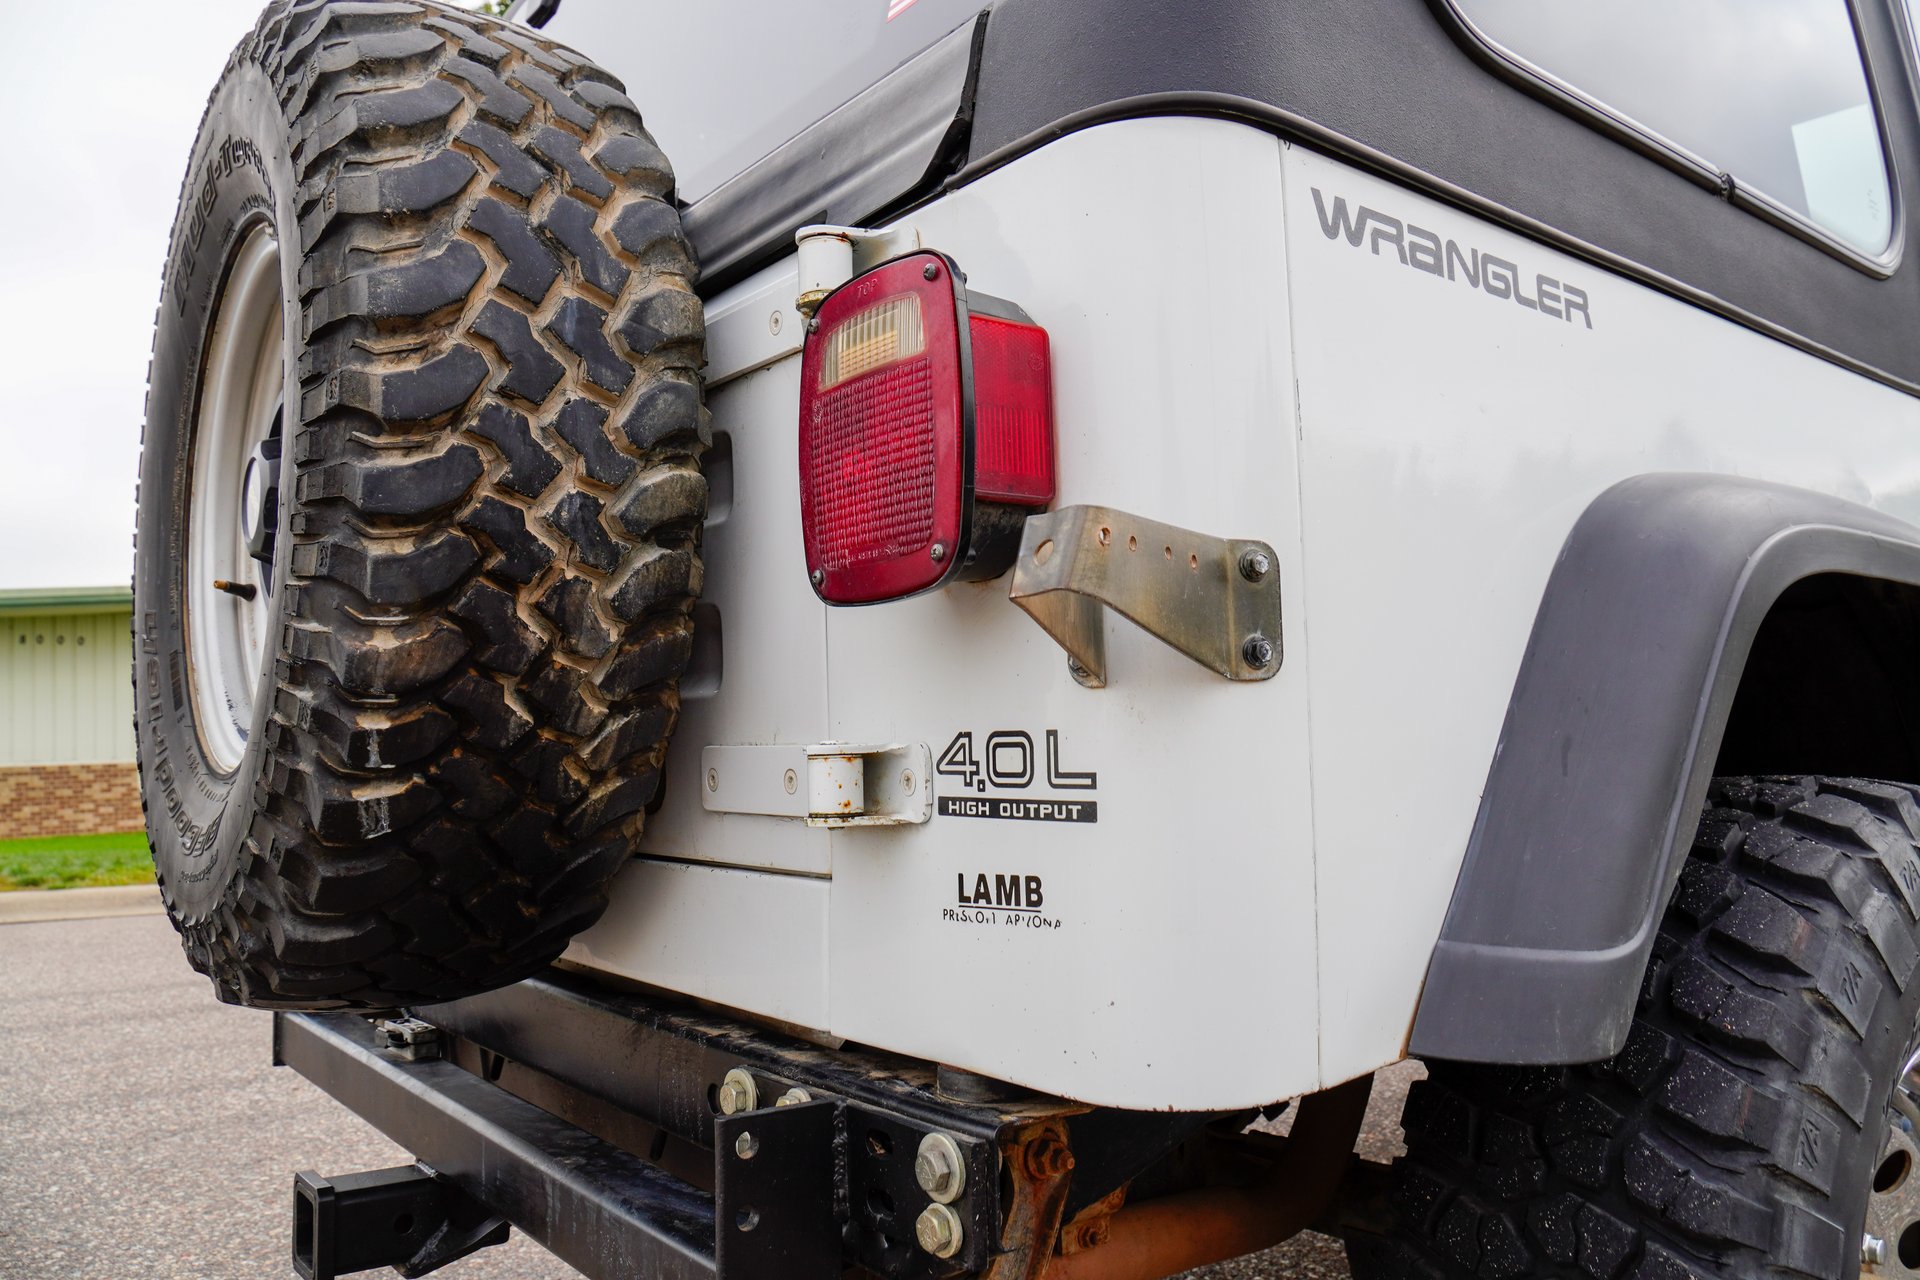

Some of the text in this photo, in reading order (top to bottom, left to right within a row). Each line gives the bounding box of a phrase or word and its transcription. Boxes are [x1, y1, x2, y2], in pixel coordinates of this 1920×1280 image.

[173, 132, 276, 317] Mud-Terra
[1310, 187, 1593, 330] WRANGLER
[857, 278, 878, 300] TOP
[948, 800, 1082, 820] HIGH OUTPUT
[957, 872, 1044, 908] LAMB
